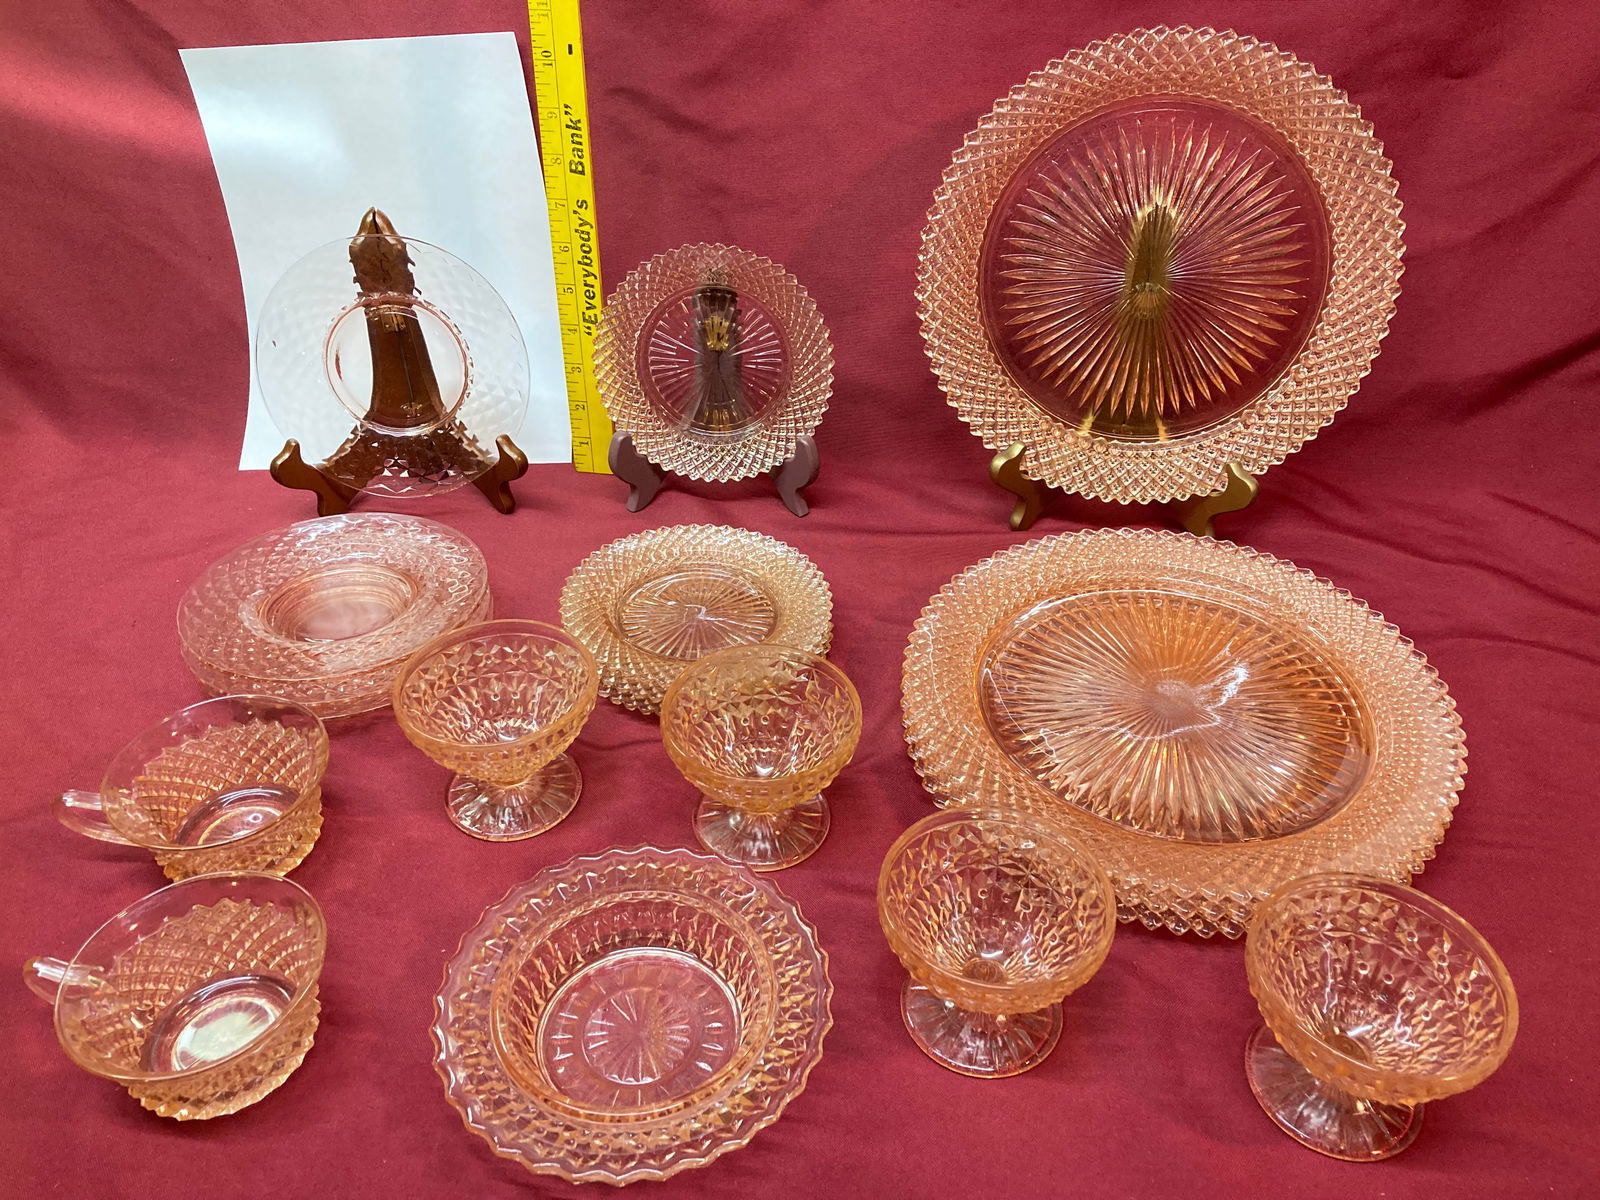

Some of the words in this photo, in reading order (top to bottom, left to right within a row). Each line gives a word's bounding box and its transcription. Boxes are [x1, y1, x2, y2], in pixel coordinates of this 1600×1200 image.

[540, 50, 554, 68] 10
[546, 111, 558, 119] 9
[550, 157, 562, 165] 8
[554, 201, 566, 209] 7
[559, 245, 570, 253] 6
[563, 286, 574, 294] 5
[571, 366, 582, 374] 3
[574, 403, 586, 411] 2
